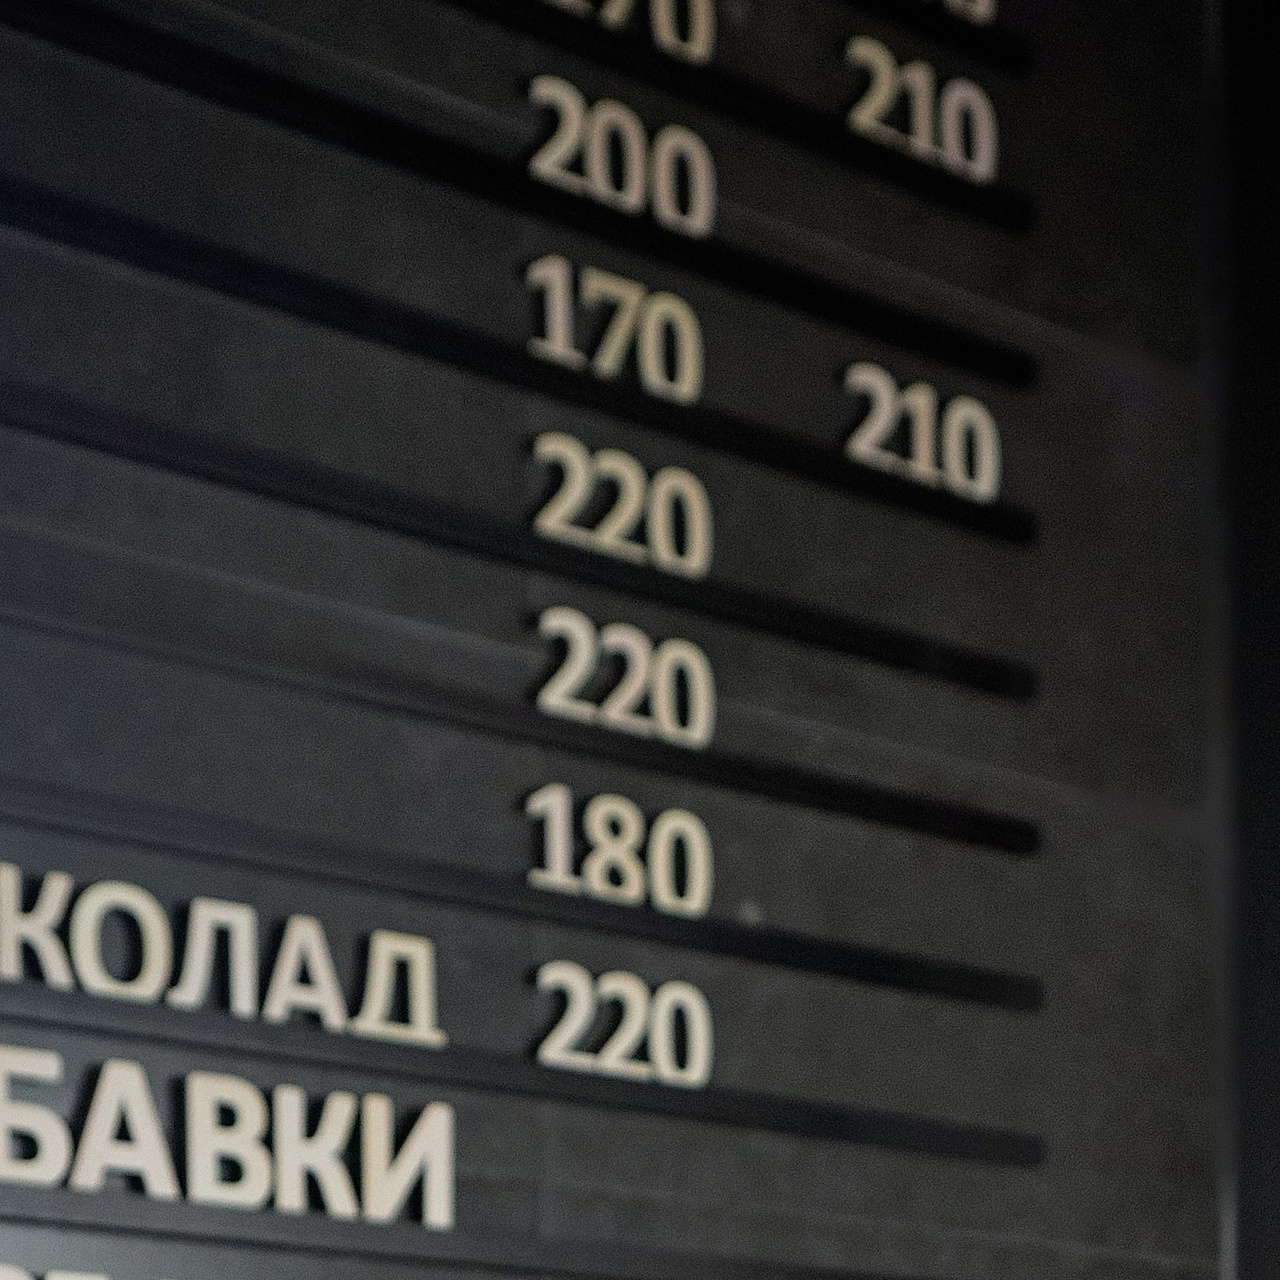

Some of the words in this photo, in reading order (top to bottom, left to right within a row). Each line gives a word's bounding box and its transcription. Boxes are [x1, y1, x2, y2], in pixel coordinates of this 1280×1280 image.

[528, 74, 716, 237] 200
[845, 35, 998, 184] 210
[526, 254, 703, 402] 170
[844, 360, 1000, 501] 210
[532, 431, 714, 580] 220
[536, 606, 716, 750] 220
[526, 782, 714, 919] 180
[536, 960, 714, 1090] 220
